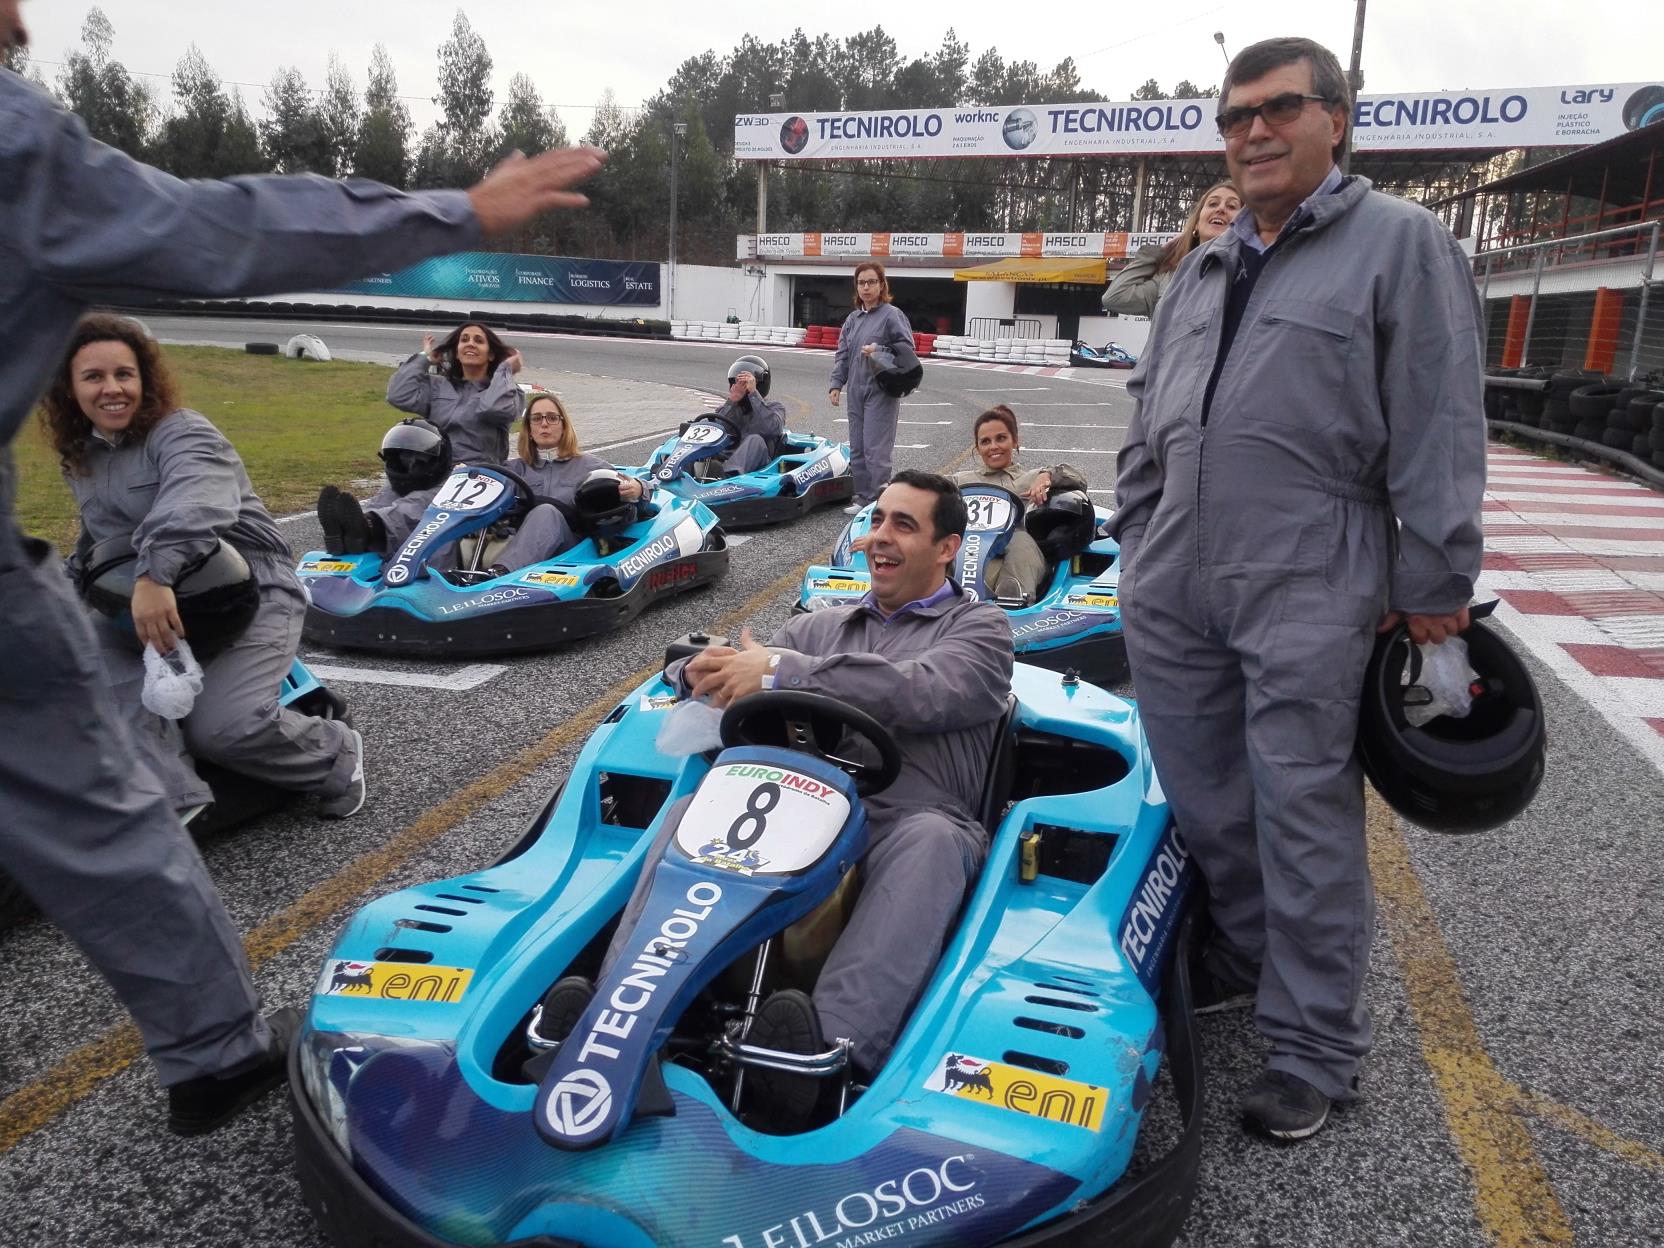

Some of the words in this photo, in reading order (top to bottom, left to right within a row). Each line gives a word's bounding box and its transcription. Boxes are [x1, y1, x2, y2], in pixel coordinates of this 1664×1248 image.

[954, 110, 1000, 123] worknc
[1353, 95, 1528, 128] ECNIROLO
[1557, 112, 1589, 121] INJEÇÃO
[735, 117, 769, 126] ZW3D
[1047, 105, 1203, 133] TECNIROLO
[816, 114, 943, 139] TECNIROLO
[1561, 128, 1601, 136] BORRACHA
[759, 236, 790, 246] HASCO
[823, 236, 857, 246] HASCO
[892, 236, 929, 246] HASCO
[966, 236, 1005, 247] HASCO
[1045, 236, 1087, 247] HASCO
[468, 274, 500, 283] ATIVOS
[518, 276, 555, 286] FINANCE
[570, 278, 611, 289] LOGISTICS
[625, 281, 654, 290] ESTATE
[687, 427, 711, 441] 32
[796, 459, 829, 485] TECNIROLO
[449, 478, 488, 506] 12
[967, 500, 993, 525] 31
[396, 512, 450, 564] TECNIROLO
[620, 535, 674, 578] TECNIROLO
[544, 575, 577, 585] eni
[834, 581, 867, 592] eni
[438, 587, 528, 615] LEILOSOC
[1091, 598, 1118, 607] en
[1011, 611, 1082, 638] EILOSOC
[726, 781, 781, 851] 8
[577, 881, 723, 1064] TECNIROLO
[381, 968, 465, 1002] eni
[1004, 1081, 1099, 1128] eni
[836, 1221, 905, 1248] MARKET
[907, 1192, 985, 1230] PARTNERS
